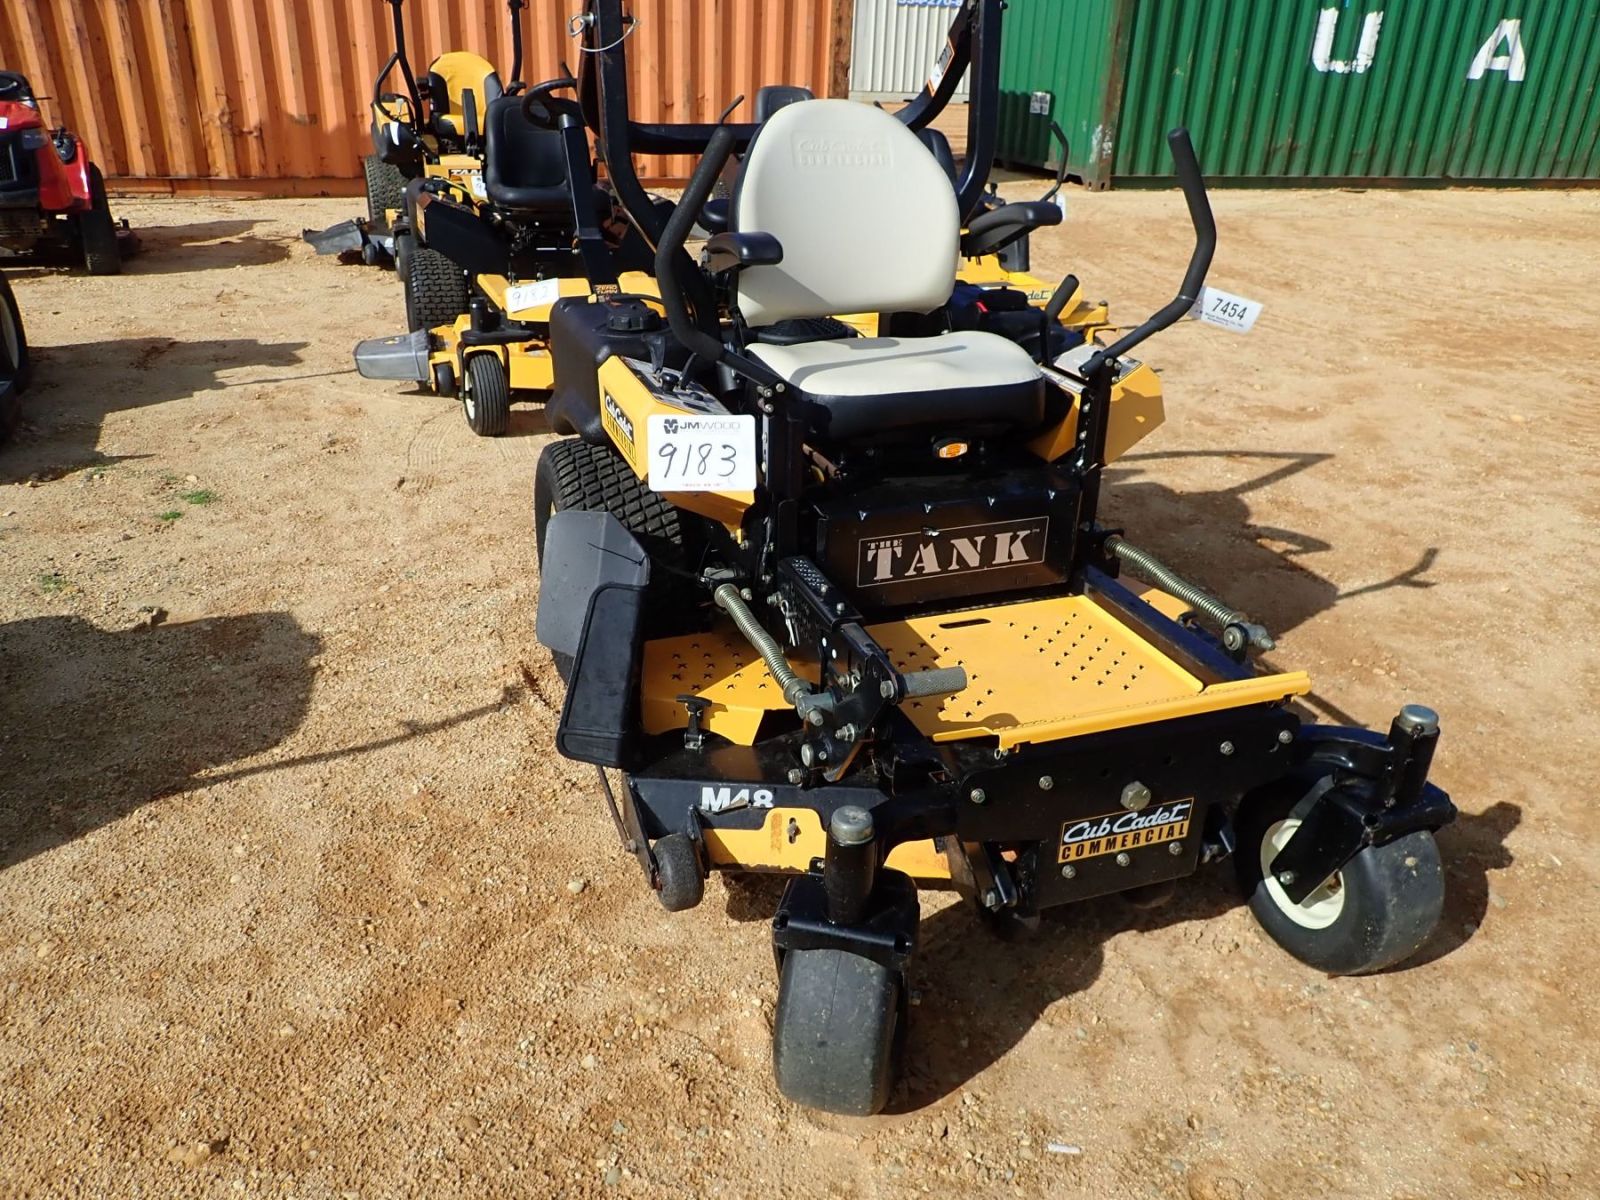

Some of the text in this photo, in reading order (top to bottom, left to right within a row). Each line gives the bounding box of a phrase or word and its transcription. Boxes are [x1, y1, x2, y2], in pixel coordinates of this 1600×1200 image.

[1312, 7, 1526, 81] U A
[1212, 297, 1248, 321] 7454
[658, 442, 737, 479] 9183
[866, 530, 1031, 581] TANK
[867, 539, 903, 549] THE
[701, 786, 774, 812] M48
[1061, 823, 1185, 860] COMMERCIAL
[1063, 803, 1191, 843] Cub Cadet
